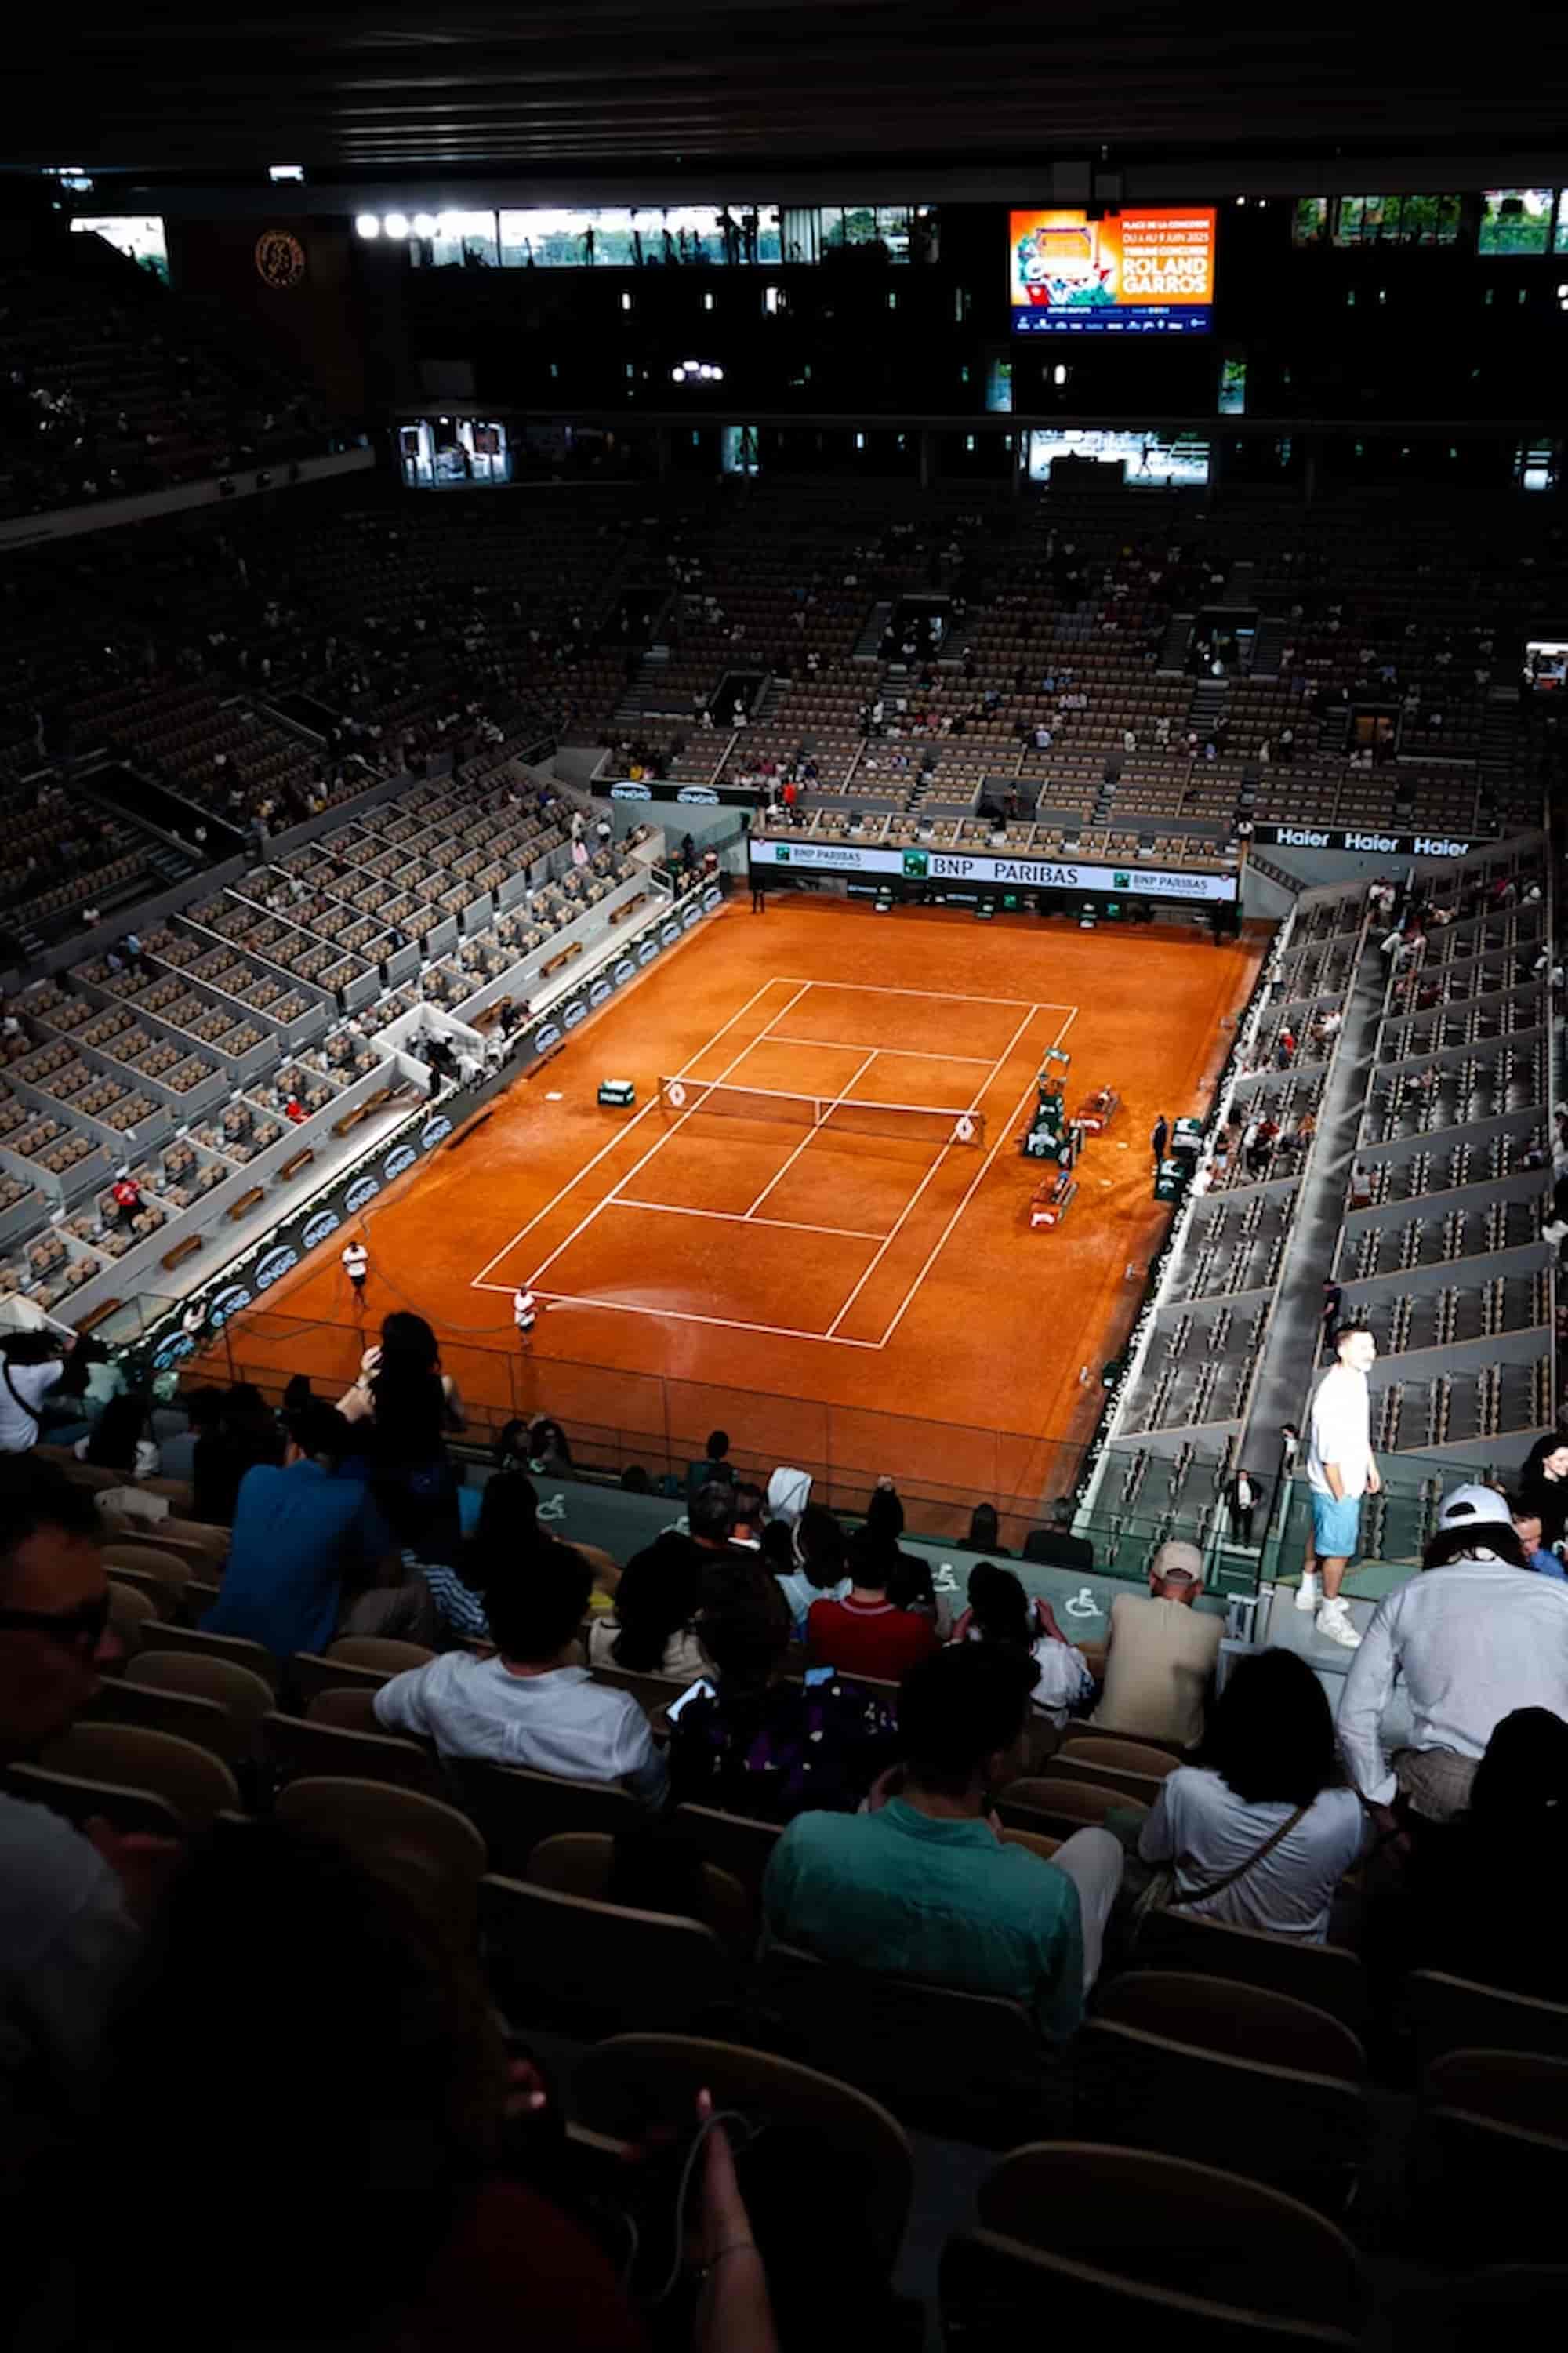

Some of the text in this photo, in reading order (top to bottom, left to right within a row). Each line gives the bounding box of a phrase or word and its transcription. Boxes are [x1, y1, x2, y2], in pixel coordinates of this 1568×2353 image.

[1123, 257, 1207, 276] ROLAND
[1123, 275, 1207, 294] GARROS
[1276, 828, 1330, 848] Haier
[1345, 832, 1399, 852] Haier
[1414, 837, 1468, 857] Haier
[794, 848, 862, 862] BNP PARIBAS
[934, 858, 1079, 884] BNP PARIBAS
[1134, 874, 1207, 890] BNP PARIBAS
